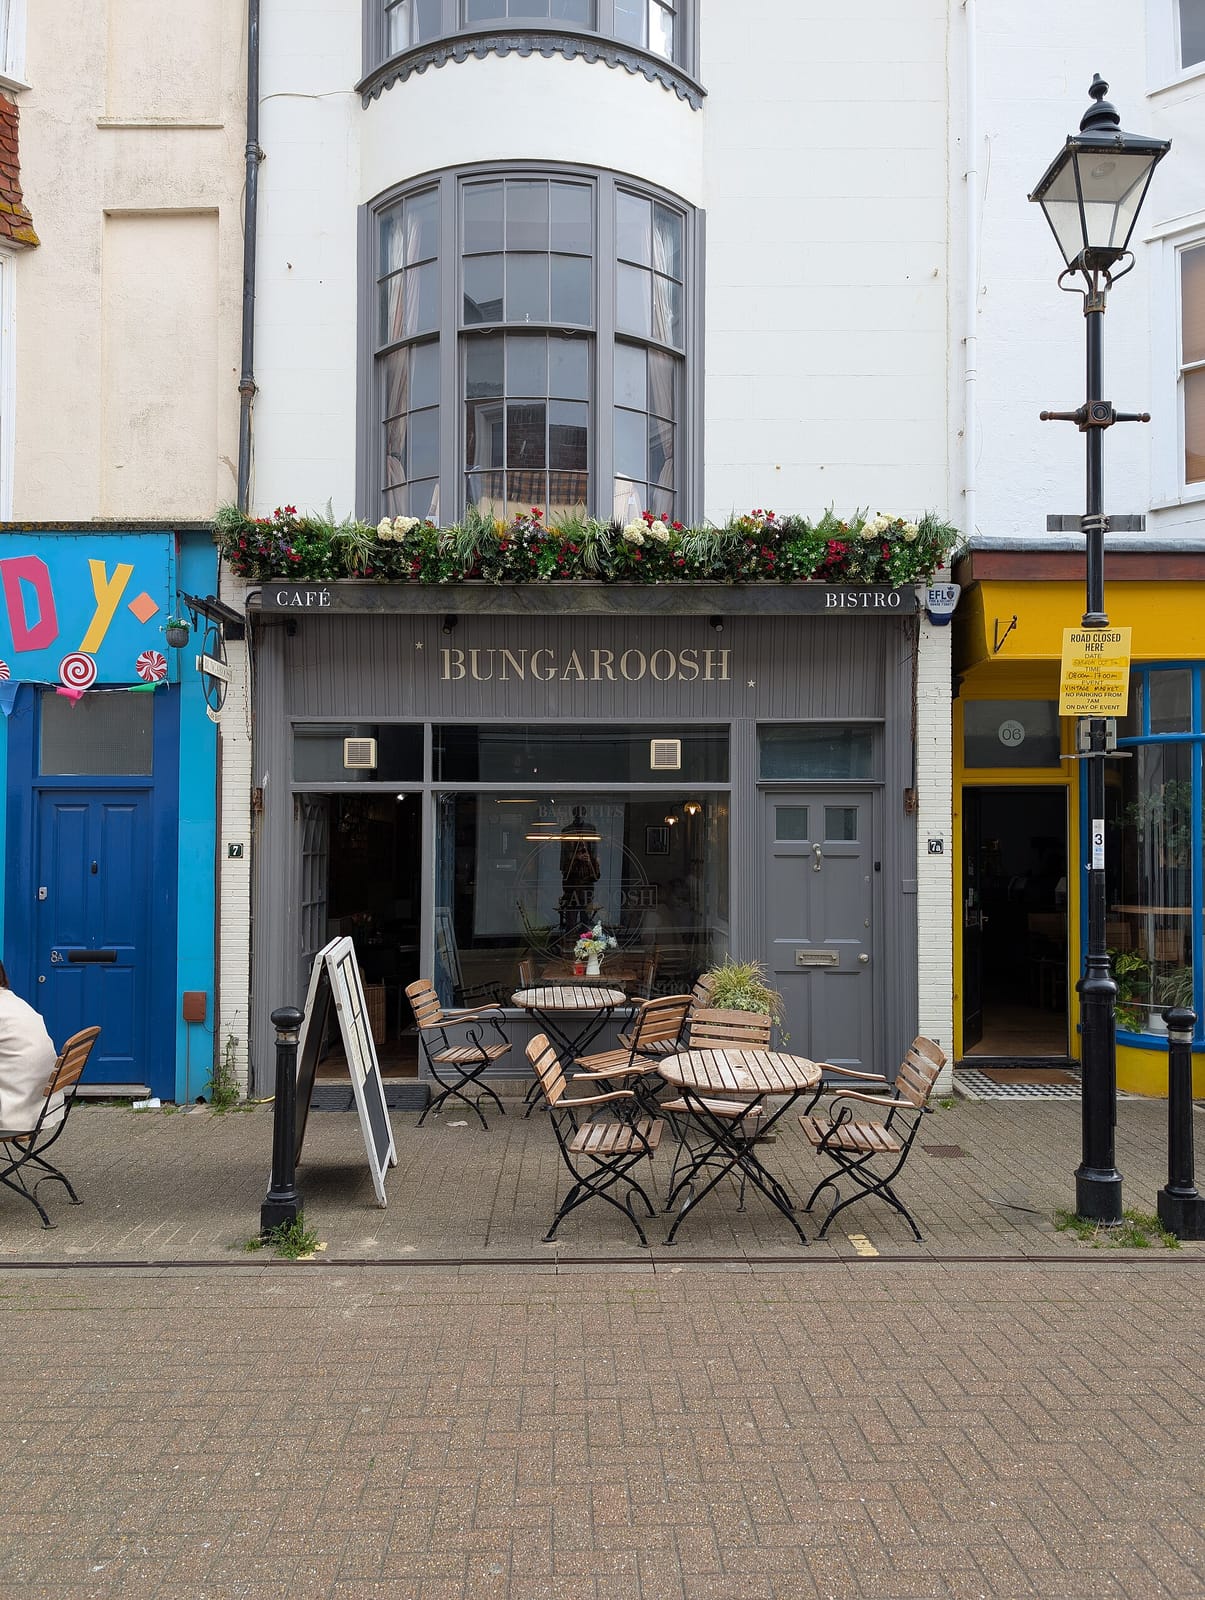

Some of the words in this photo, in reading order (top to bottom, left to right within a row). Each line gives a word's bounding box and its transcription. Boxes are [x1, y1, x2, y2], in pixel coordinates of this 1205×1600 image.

[276, 587, 331, 607] CAFÉ
[825, 592, 901, 608] BISTRO
[928, 590, 947, 600] EFL
[1070, 633, 1091, 643] ROAD
[1092, 633, 1121, 643] CLOSED
[1085, 643, 1105, 651] HERE
[439, 648, 732, 681] BUNGAROOSH
[1002, 728, 1021, 740] 06
[1094, 833, 1103, 846] 3
[232, 845, 239, 856] 7
[50, 950, 64, 962] 8A
